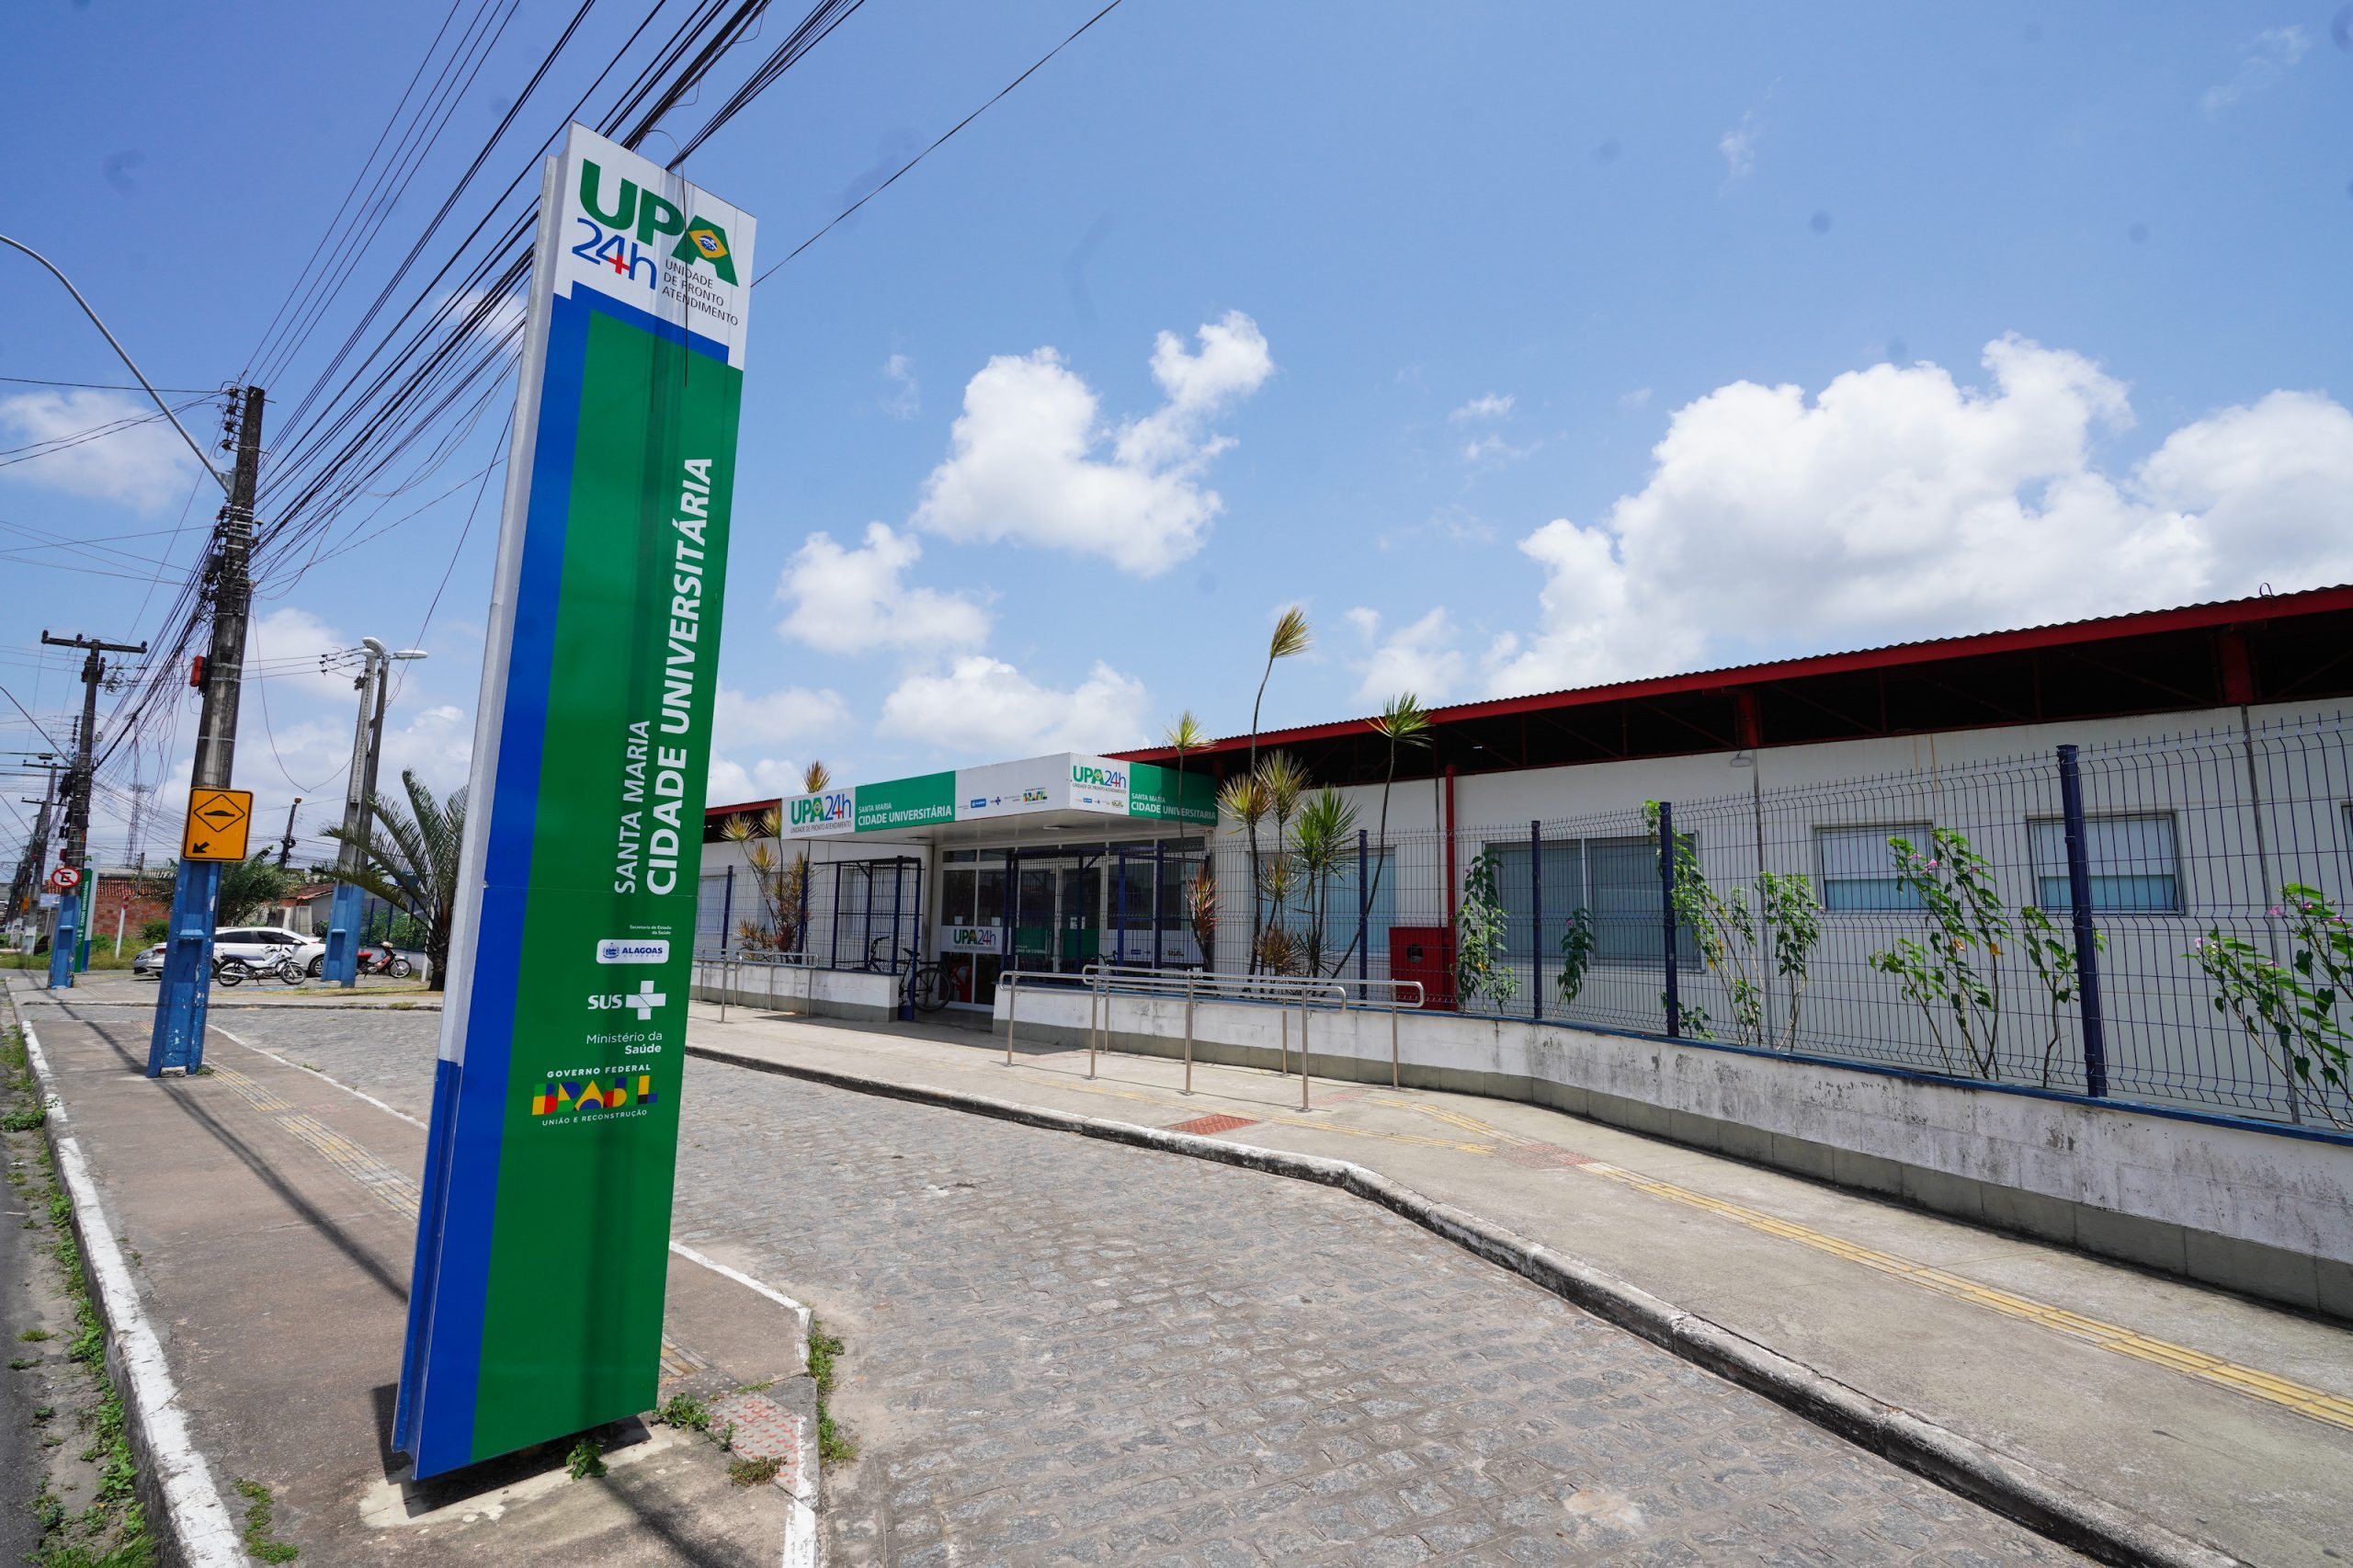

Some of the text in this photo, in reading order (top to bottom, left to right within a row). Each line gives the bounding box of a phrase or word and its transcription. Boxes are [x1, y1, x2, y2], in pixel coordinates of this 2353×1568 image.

[580, 158, 738, 287] UPA
[572, 217, 657, 290] 24h
[665, 258, 713, 289] UNIDADE
[664, 272, 724, 306] DE PRONTO
[662, 286, 738, 325] ATENDIMENTO
[647, 459, 711, 895] CIDADE UNIVERSITÁRIA
[1073, 766, 1127, 789] UPA 24h
[615, 721, 650, 893] SANTA MARIA
[858, 802, 892, 813] SANTA MARIA
[1131, 793, 1148, 801] SANTA
[1131, 801, 1162, 813] CIDADE
[790, 793, 852, 824] UPA 24h
[858, 805, 952, 826] CIDADE UNIVERSITÁRIA
[953, 929, 996, 946] UPA 24h
[587, 994, 622, 1009] SUS
[585, 1031, 663, 1044] Ministério da
[624, 1044, 662, 1055] Saúde
[547, 1063, 652, 1078] GOVERNO FEDERAL
[531, 1074, 658, 1115] BRASIL
[542, 1117, 570, 1126] UNIÃO
[581, 1108, 648, 1121] RECONSTRUÇÃO
